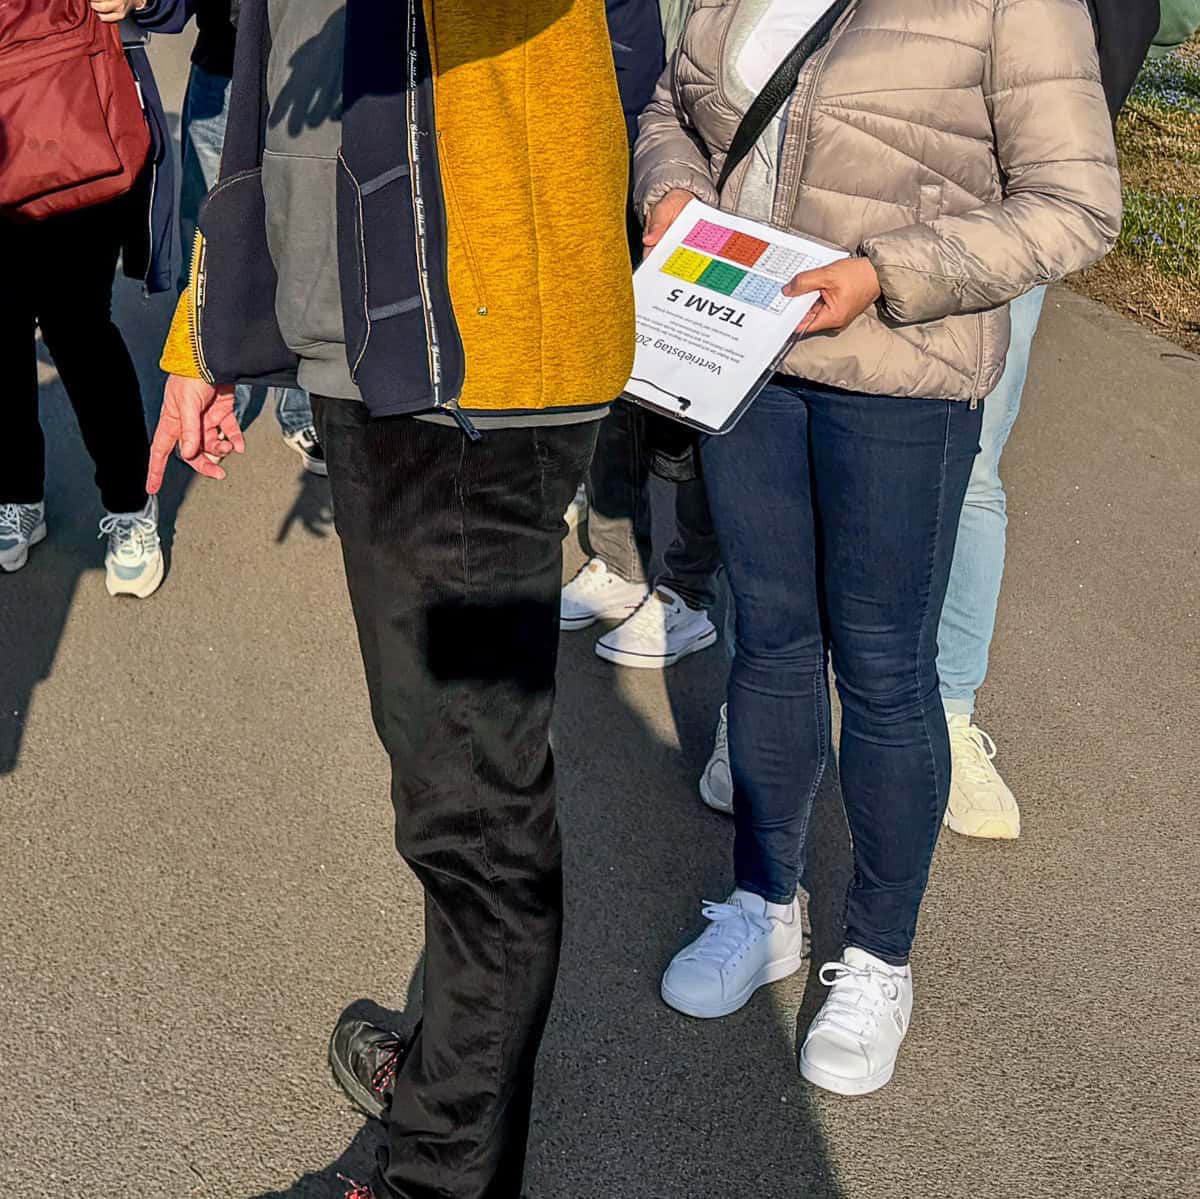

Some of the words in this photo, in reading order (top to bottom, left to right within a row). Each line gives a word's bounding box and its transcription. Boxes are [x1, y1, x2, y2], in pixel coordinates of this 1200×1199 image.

[666, 288, 684, 302] 5
[684, 294, 746, 328] TEAM
[653, 338, 722, 376] Vertriebstag
